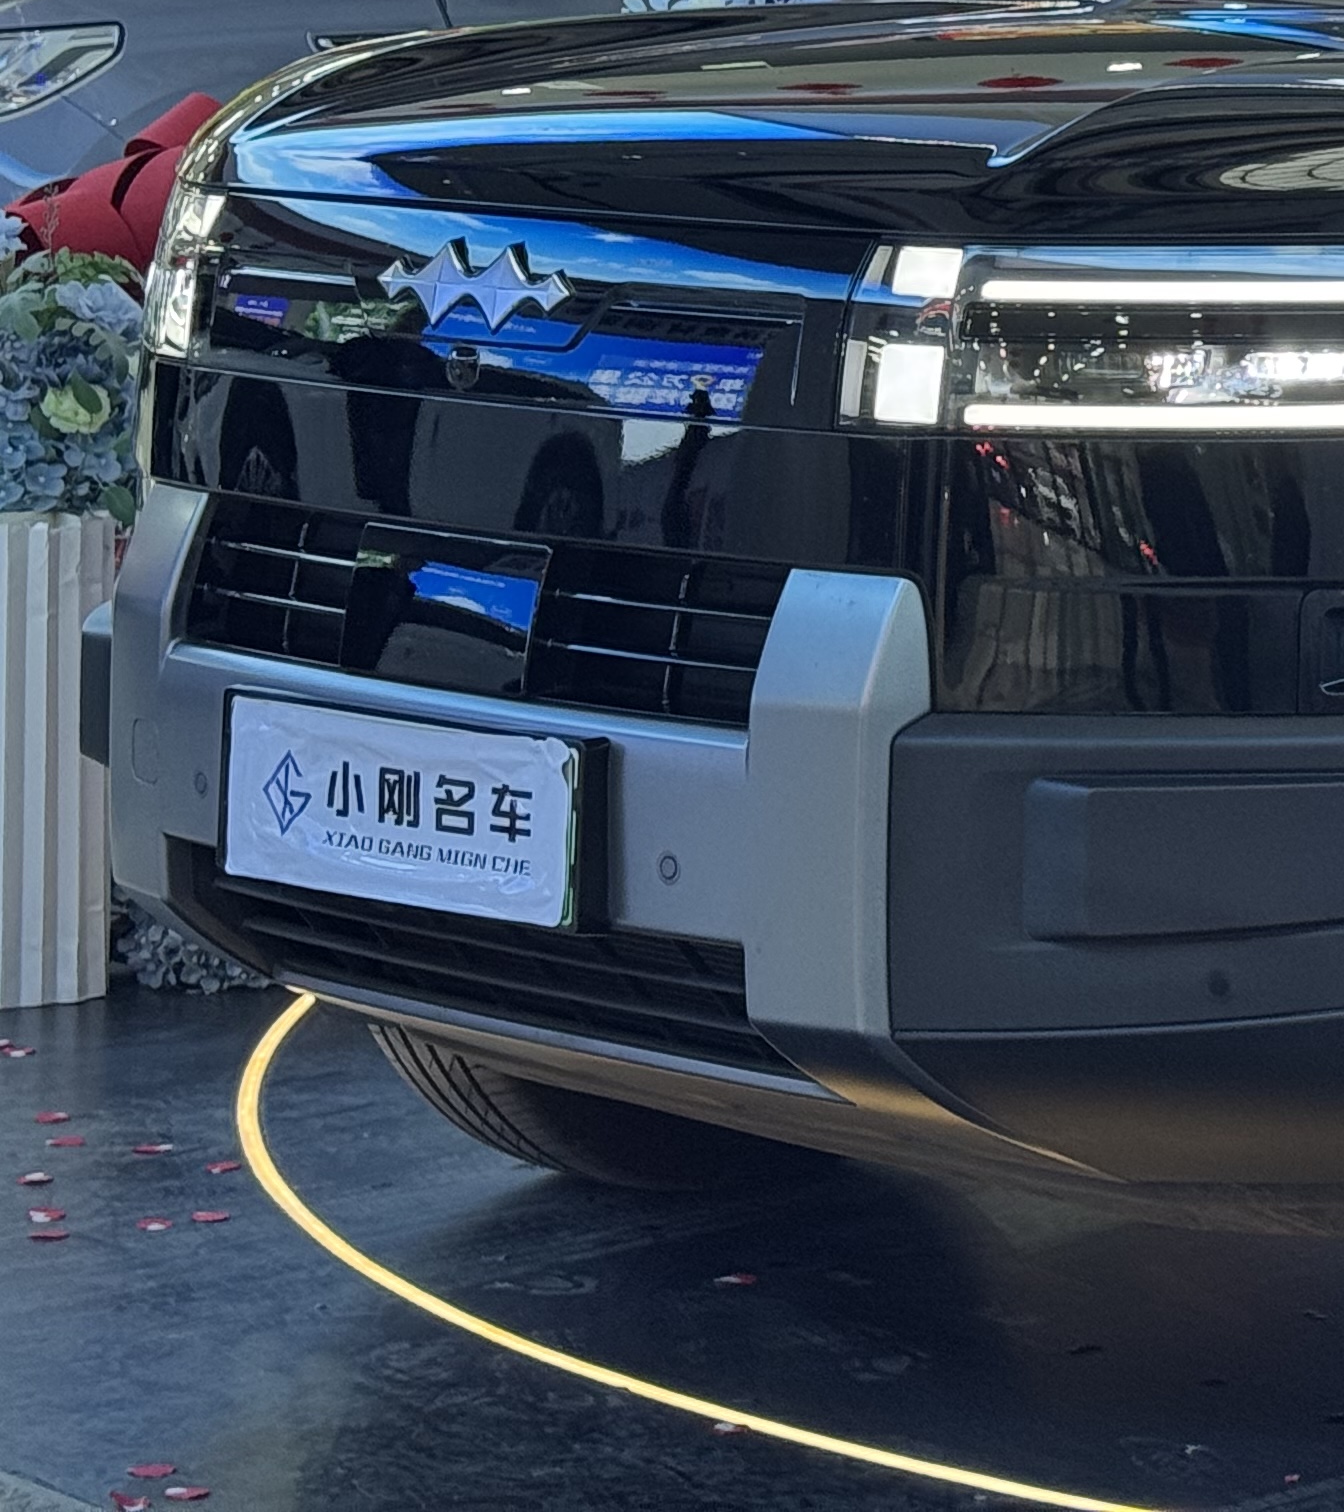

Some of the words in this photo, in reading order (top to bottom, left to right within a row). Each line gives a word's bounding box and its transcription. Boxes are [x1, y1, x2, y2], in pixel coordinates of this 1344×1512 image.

[326, 760, 533, 843] 小刚名车
[322, 829, 374, 853] XIAO
[378, 840, 433, 862] GANG
[435, 847, 488, 871] MIGN
[490, 859, 532, 877] CHE
